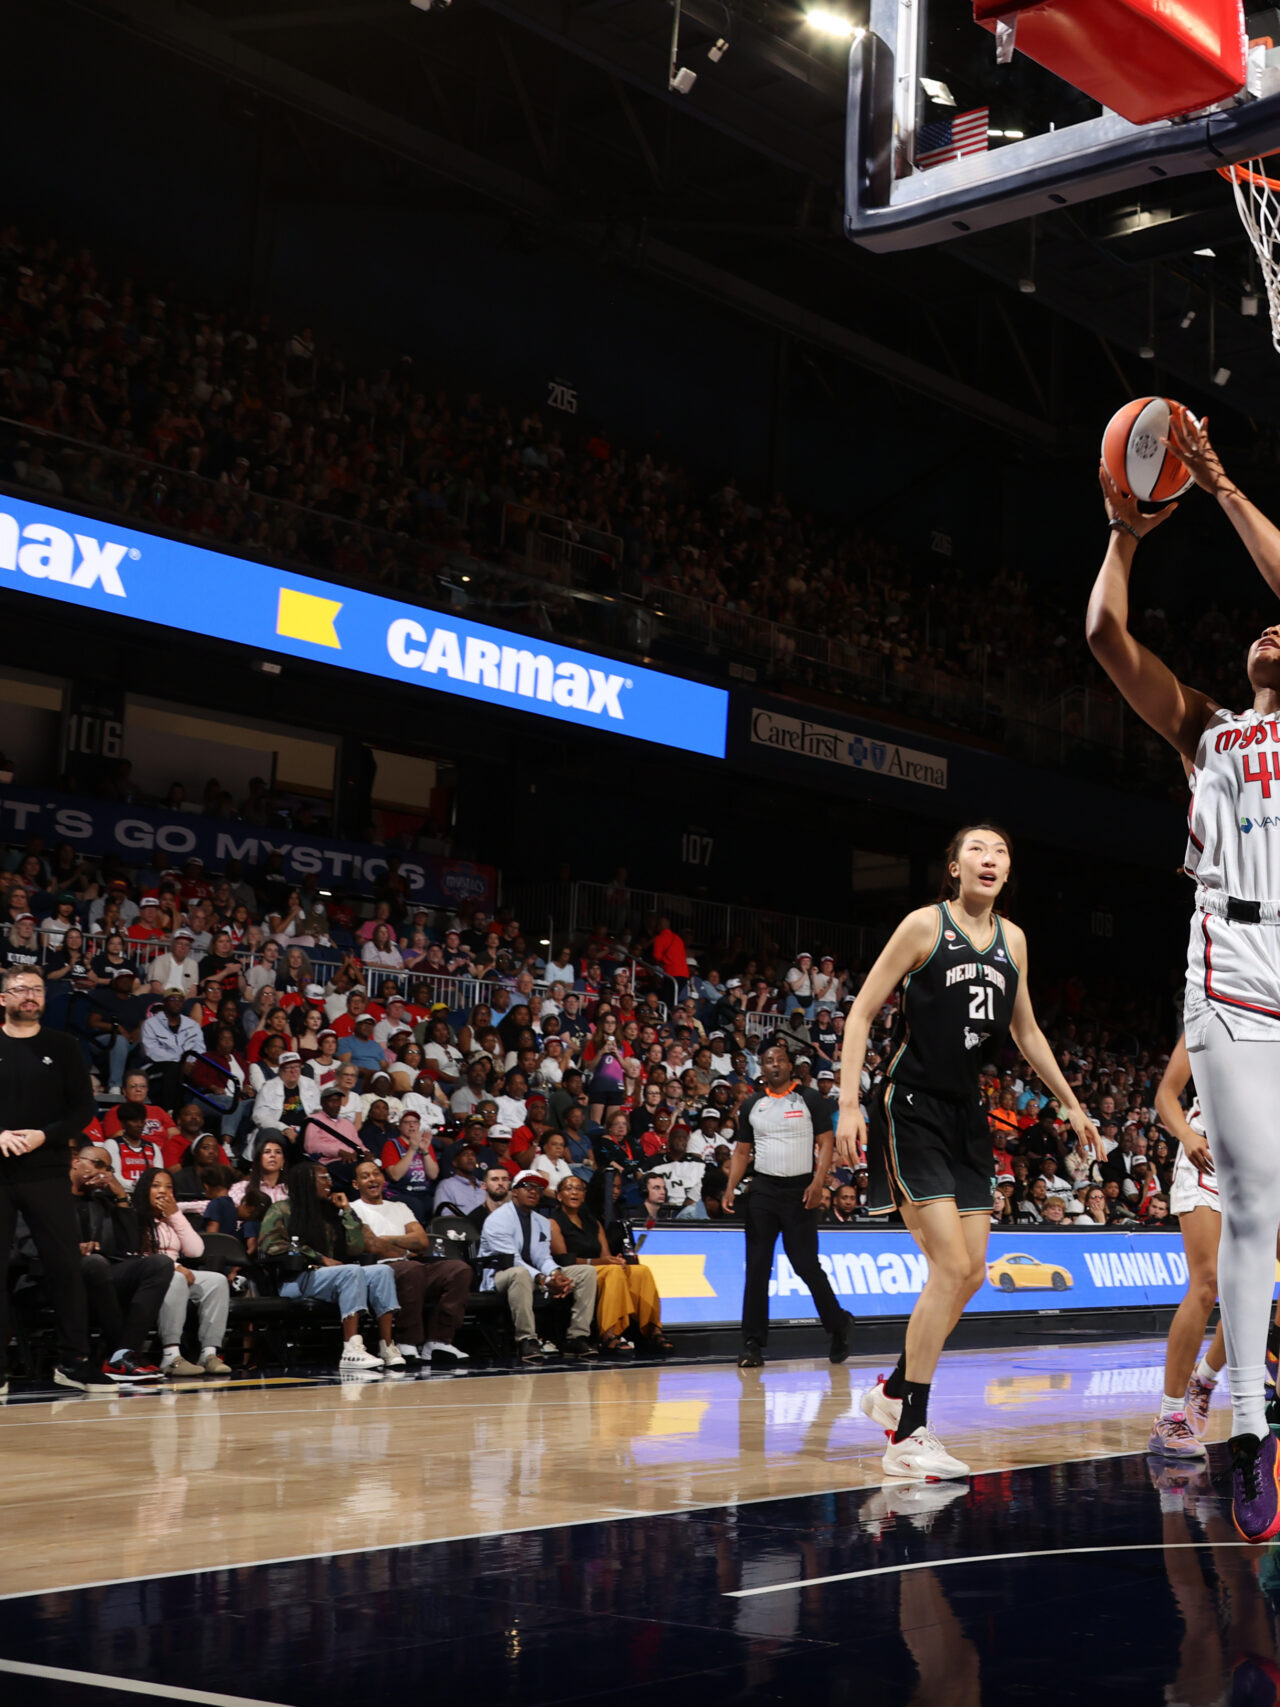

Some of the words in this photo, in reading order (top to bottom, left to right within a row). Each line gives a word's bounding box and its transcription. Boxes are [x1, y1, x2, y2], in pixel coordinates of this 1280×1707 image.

[547, 381, 578, 414] 205
[68, 713, 123, 759] 106
[753, 711, 845, 761] CareFirst
[888, 747, 946, 787] Arena
[0, 800, 94, 839] T'S
[114, 819, 197, 854] GO
[215, 831, 426, 891] MYSTICS
[681, 831, 714, 867] 107
[945, 963, 977, 988] NEW
[968, 985, 995, 1020] 21
[1083, 1252, 1172, 1288] WANNA
